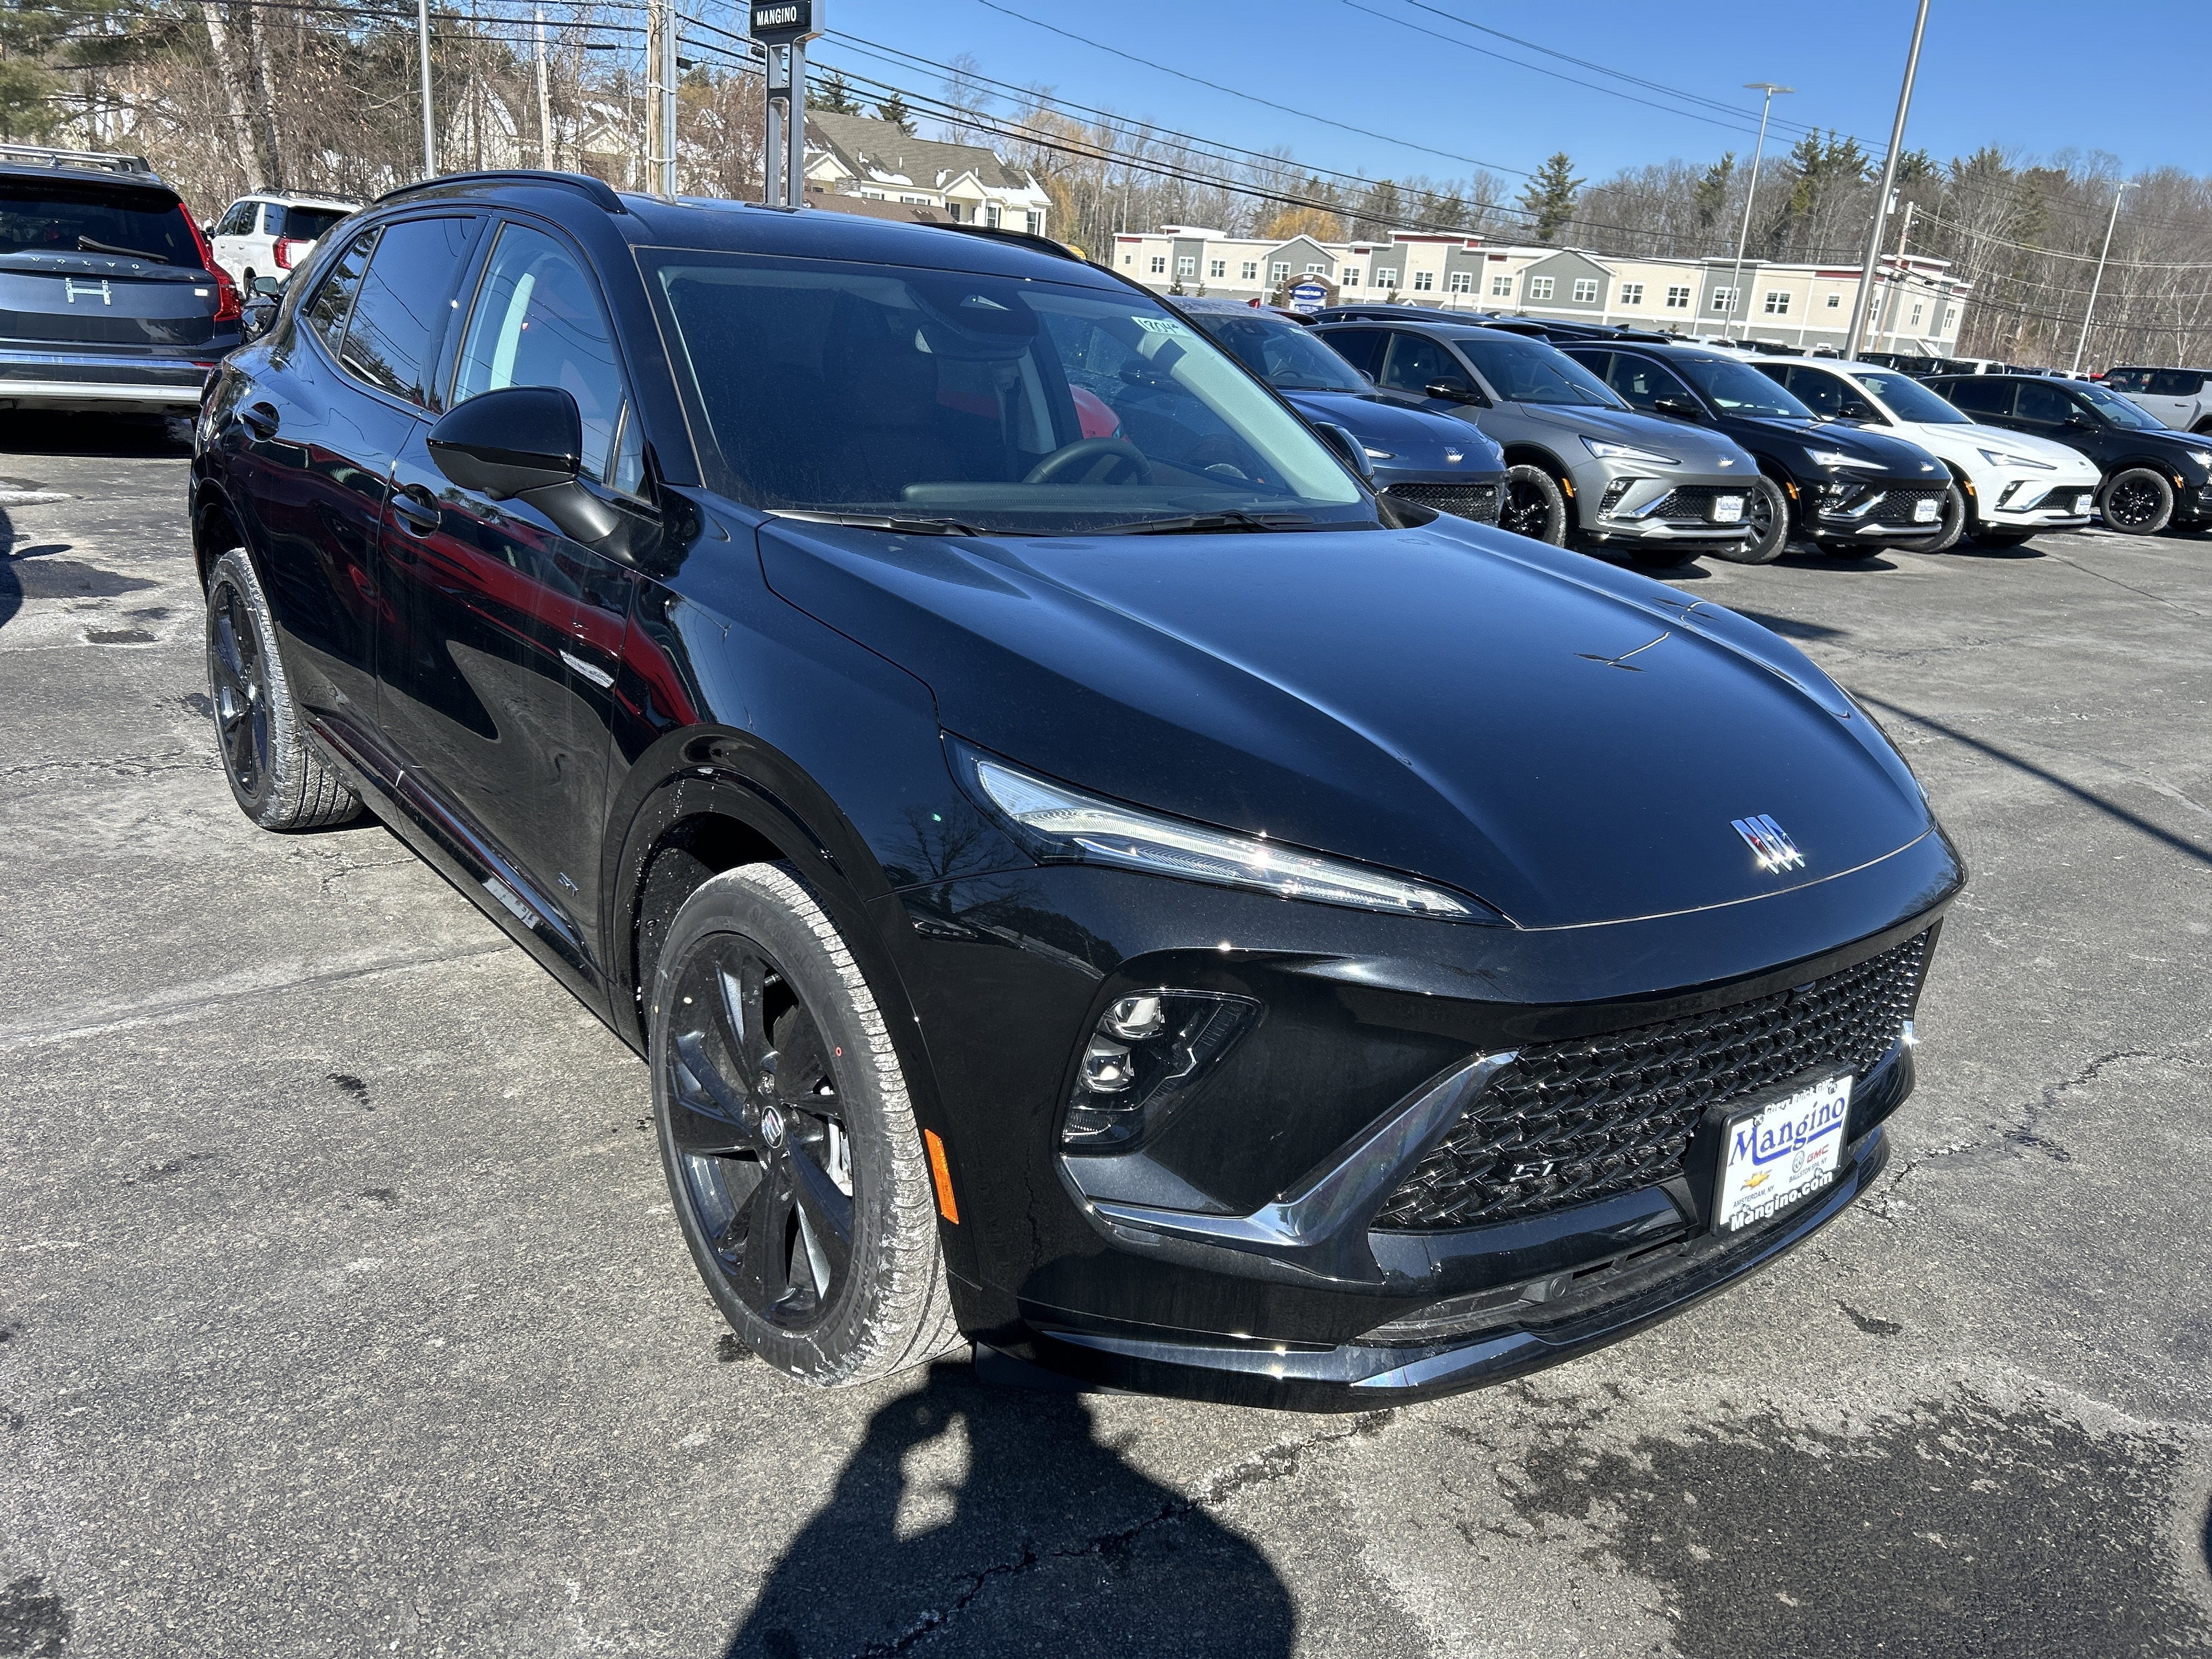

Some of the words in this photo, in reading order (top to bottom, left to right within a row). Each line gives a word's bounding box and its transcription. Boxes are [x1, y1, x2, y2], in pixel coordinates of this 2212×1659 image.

[757, 5, 797, 26] MANGINO
[30, 256, 139, 270] VOLVO
[1728, 1097, 1845, 1167] Mangino
[1807, 1143, 1829, 1164] GMC
[1789, 1165, 1811, 1183] BALLSTON
[1821, 1156, 1827, 1165] NY
[1729, 1170, 1833, 1232] Mangino.com
[1733, 1188, 1767, 1209] AMSTERDAM,
[1767, 1184, 1775, 1193] NY
